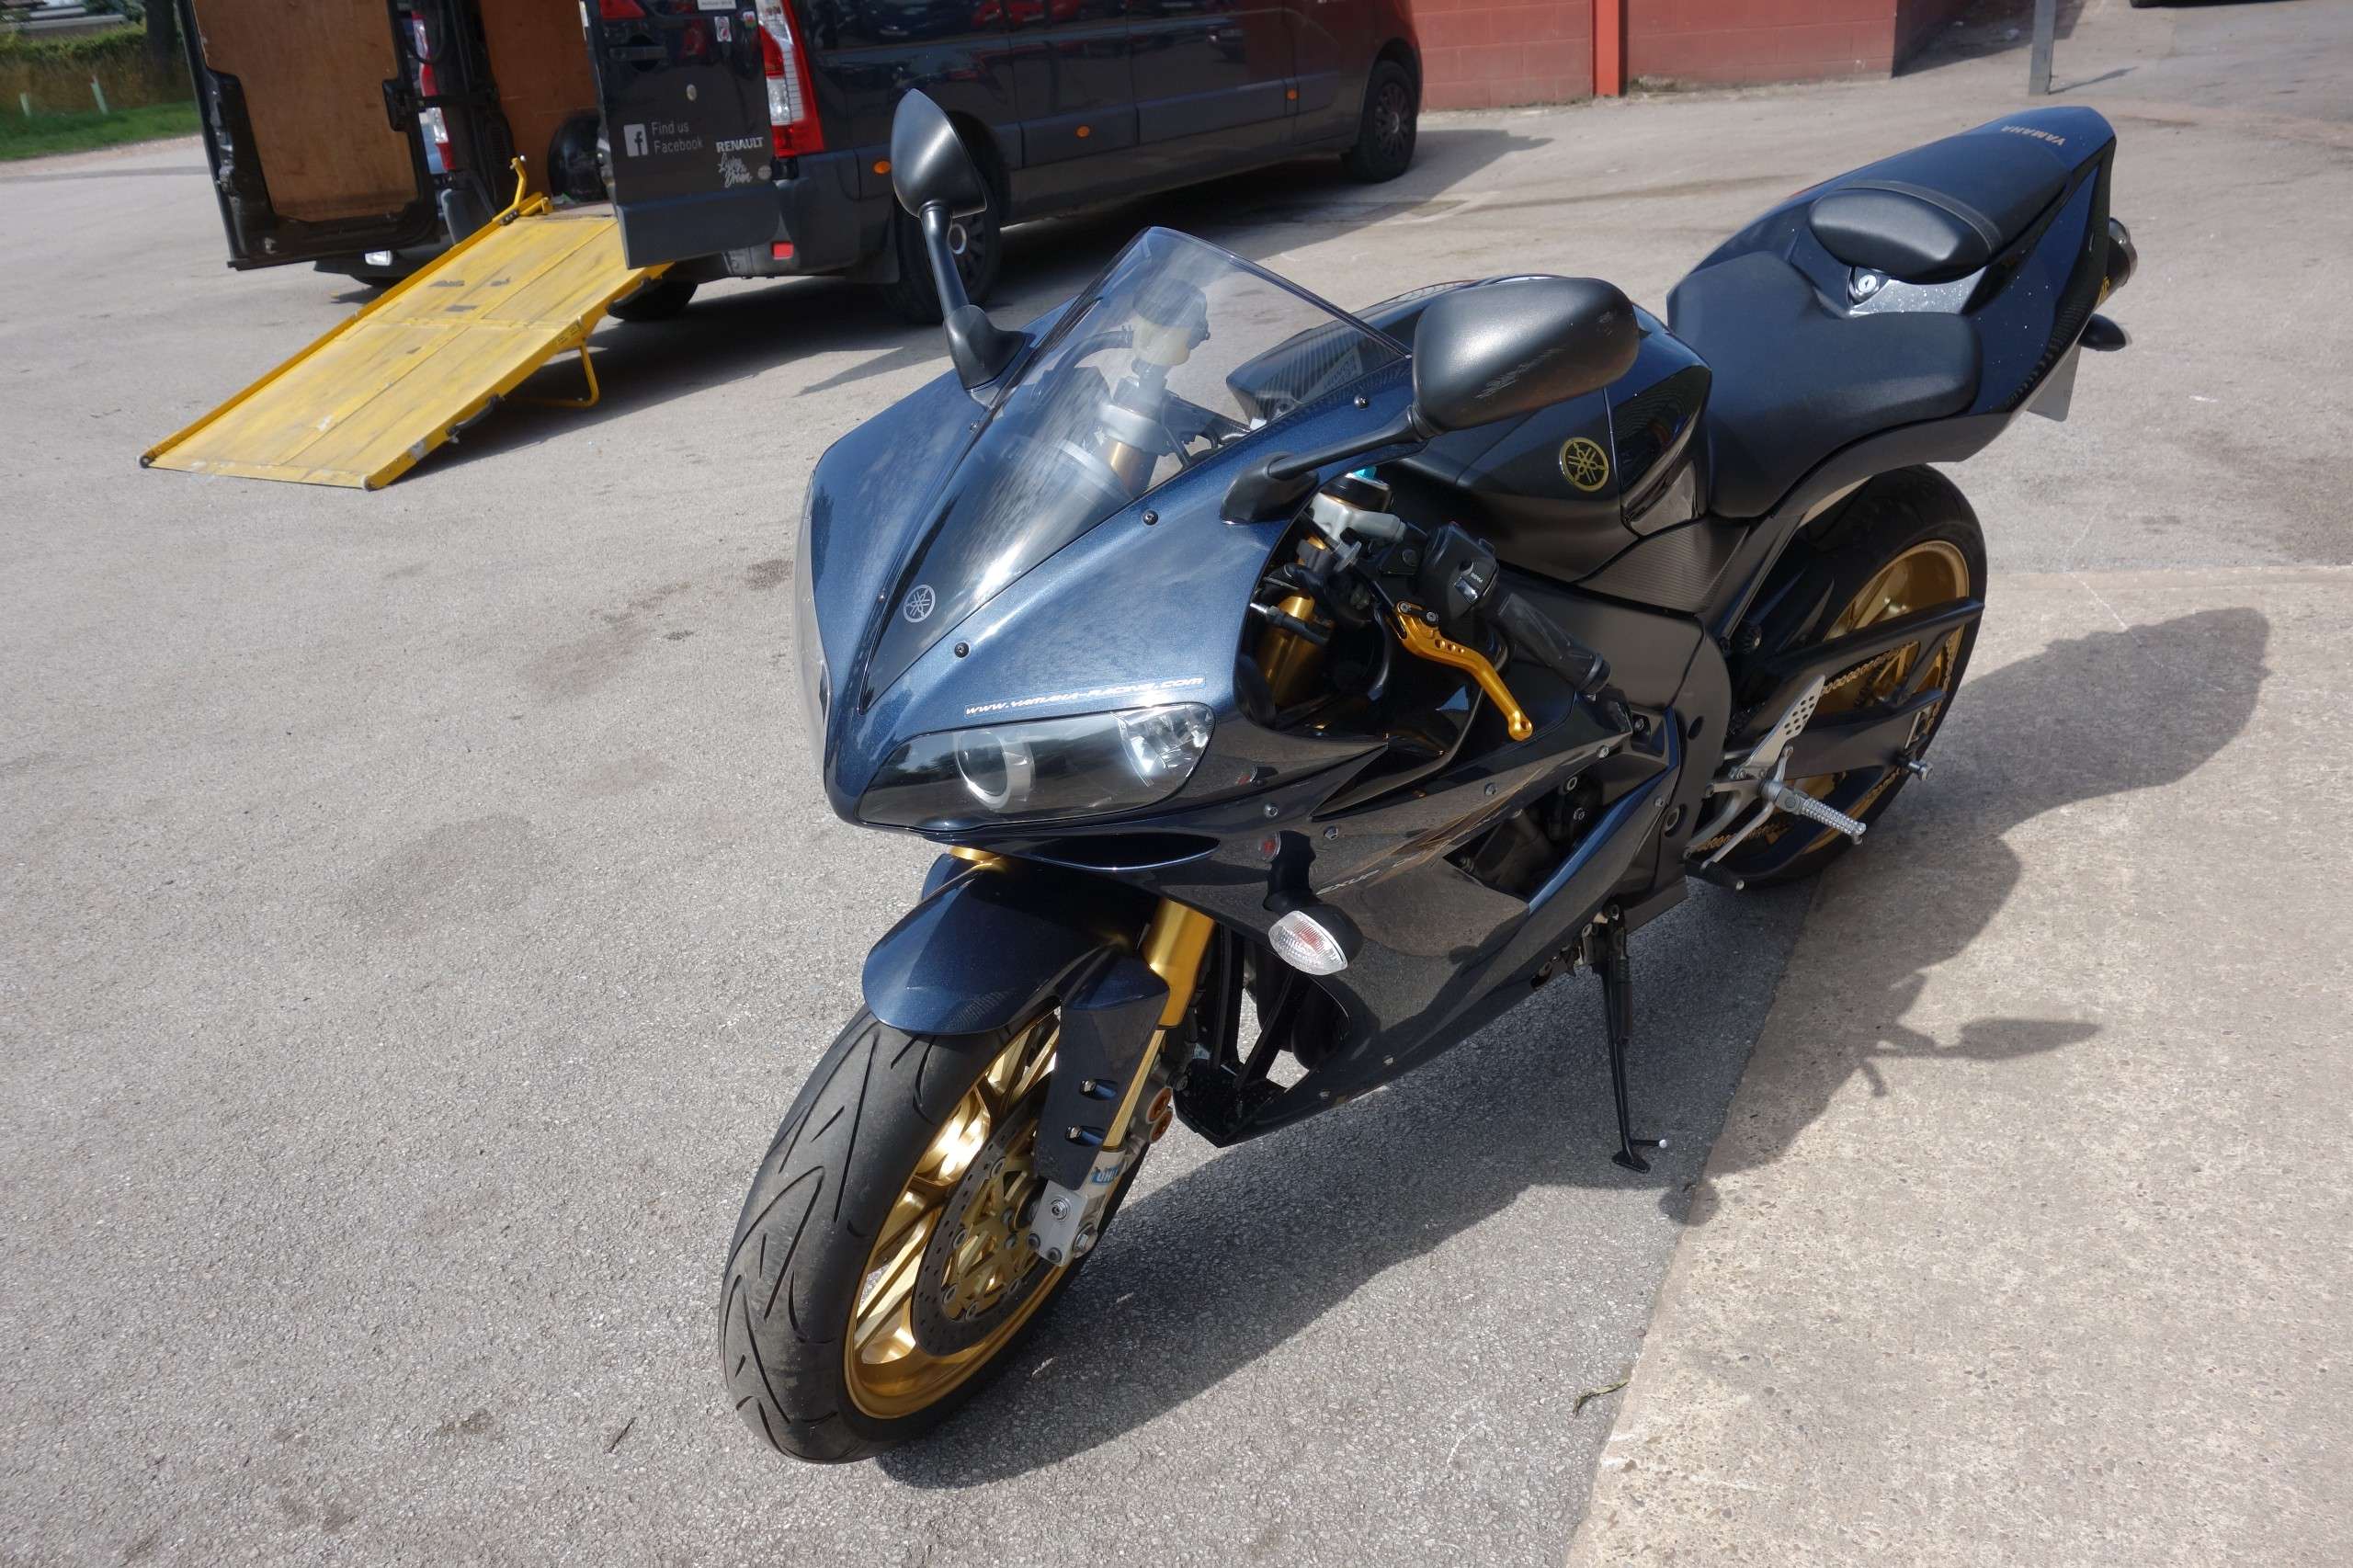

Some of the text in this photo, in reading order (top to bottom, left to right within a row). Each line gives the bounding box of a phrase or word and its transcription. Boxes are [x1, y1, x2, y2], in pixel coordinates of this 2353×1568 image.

[651, 121, 689, 135] Find us
[2001, 126, 2066, 145] YAMAHA
[654, 137, 703, 154] Facebook
[716, 137, 764, 153] RENAULT
